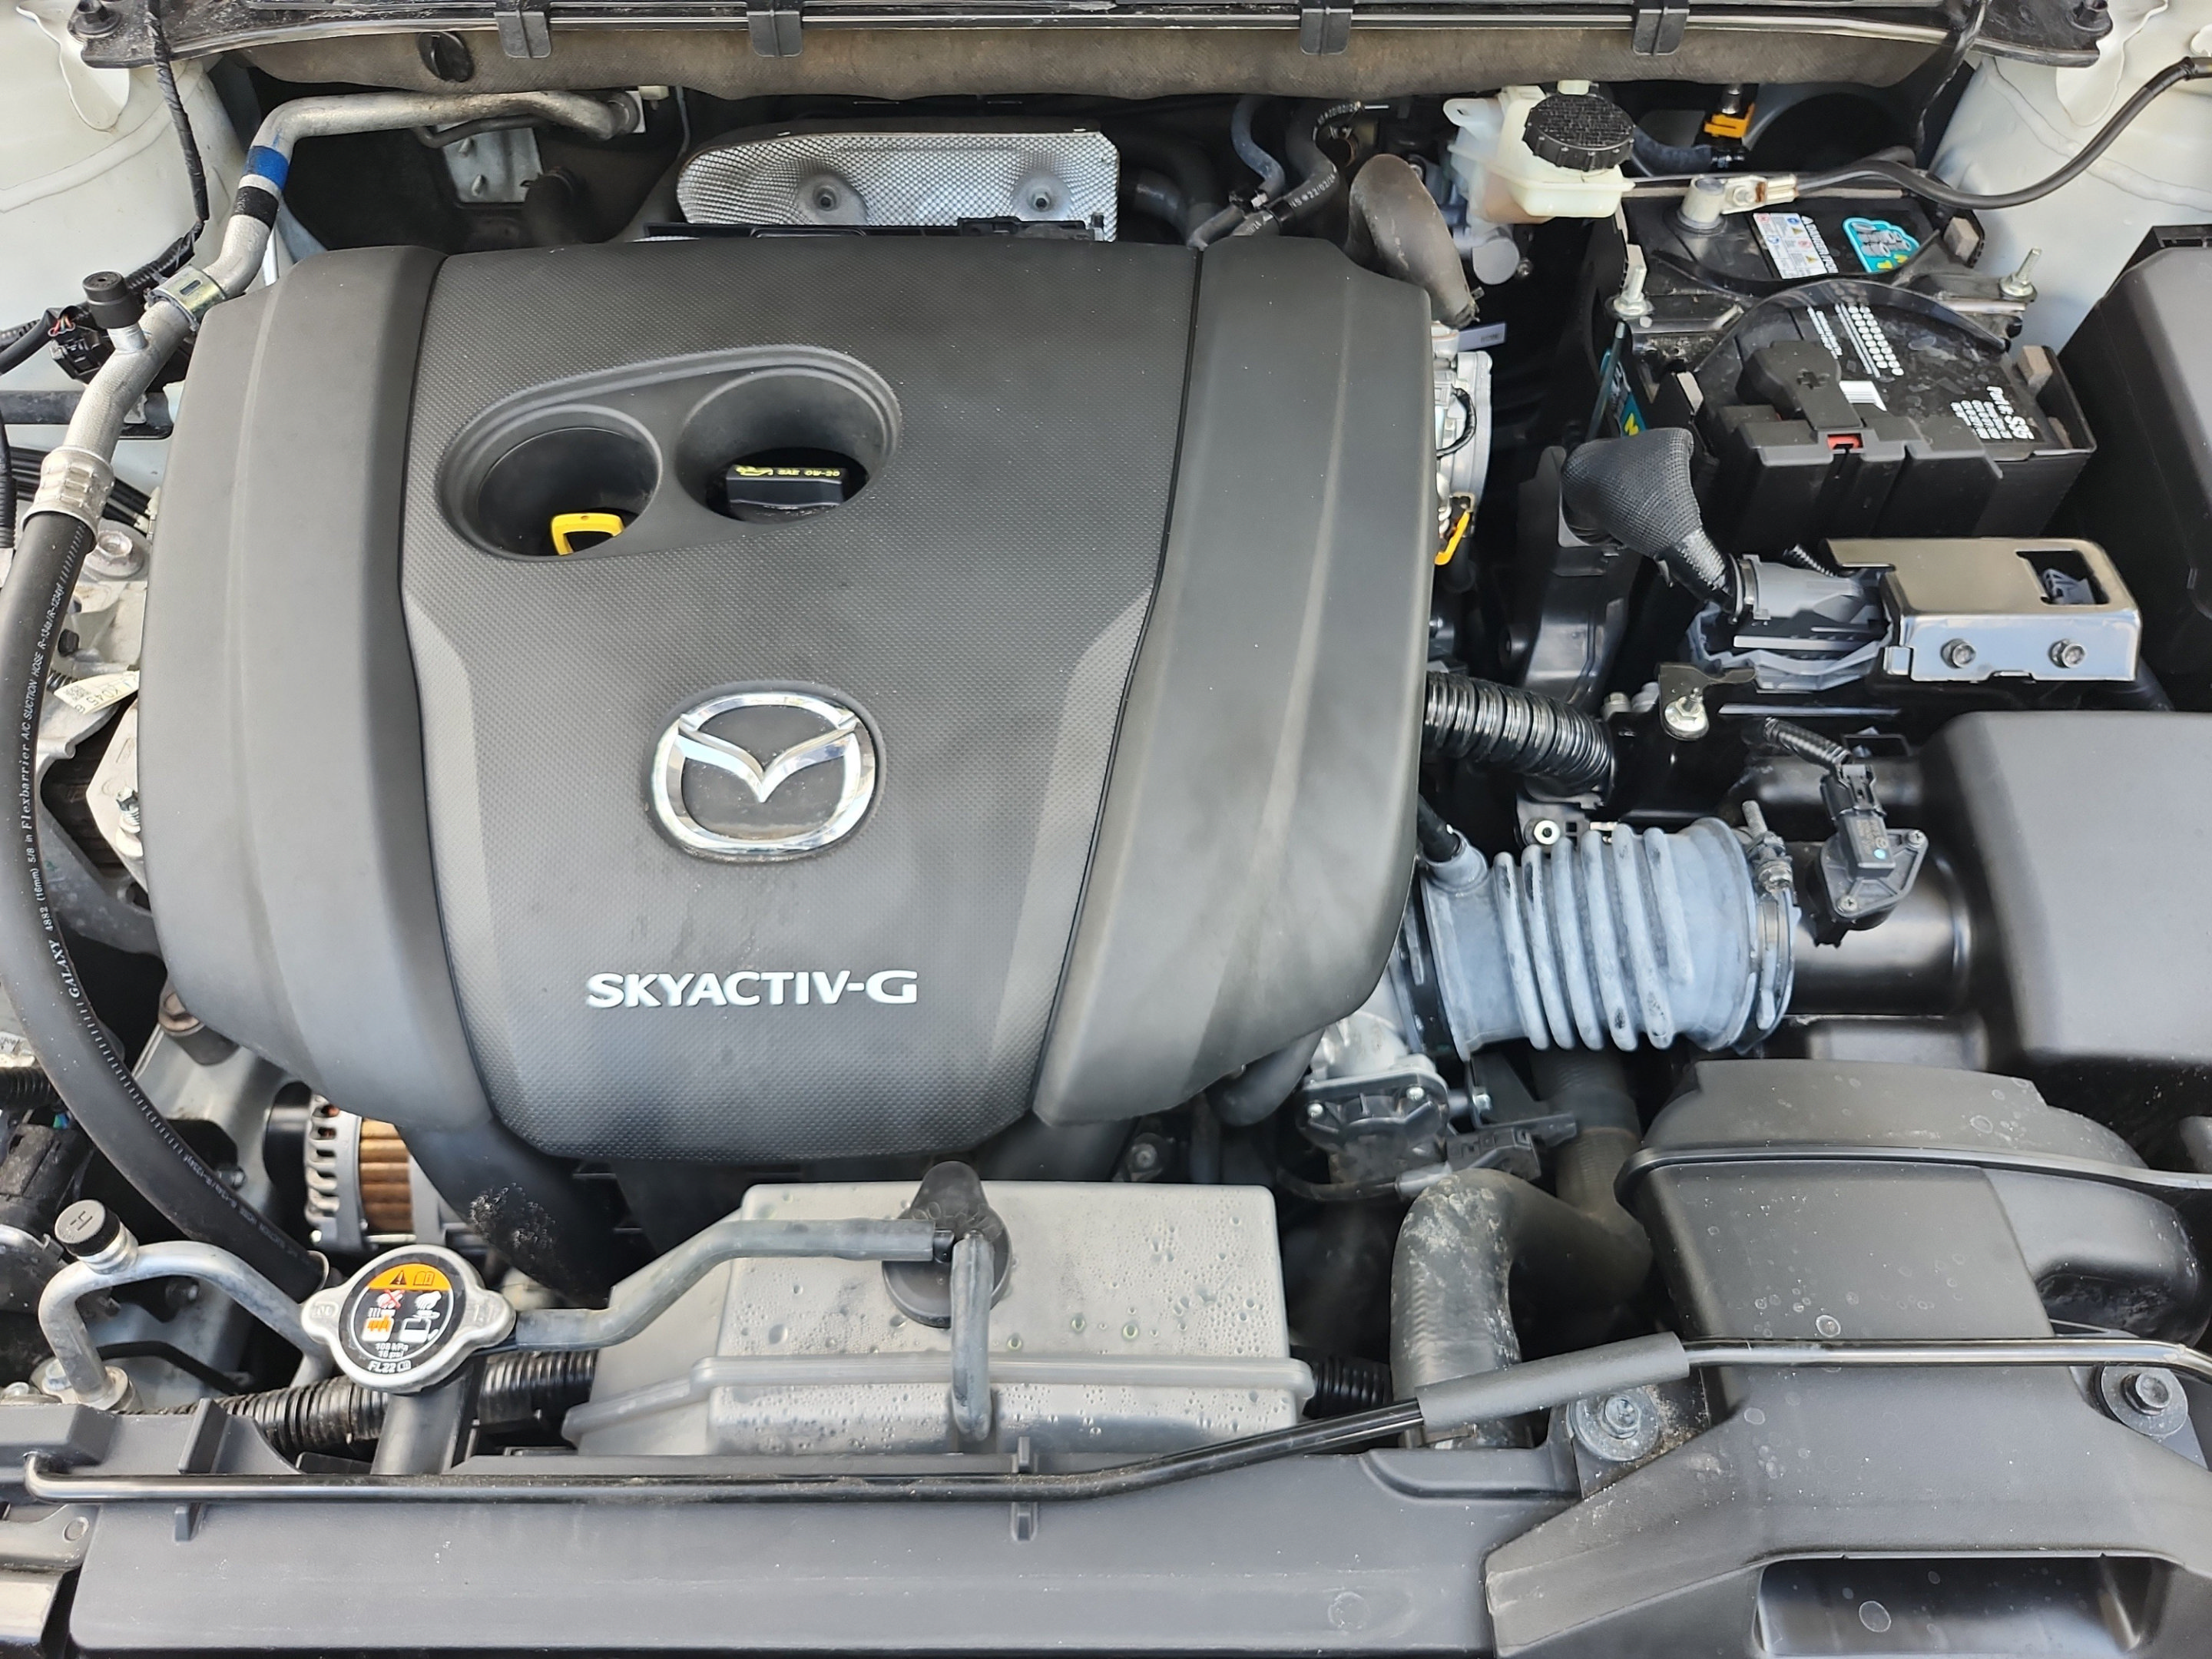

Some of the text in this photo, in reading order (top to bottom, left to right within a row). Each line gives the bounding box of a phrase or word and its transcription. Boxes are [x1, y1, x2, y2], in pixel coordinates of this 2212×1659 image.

[2004, 415, 2035, 440] S35
[31, 651, 44, 677] HOSE
[23, 679, 38, 720] SUCTION
[21, 721, 31, 740] A/C
[19, 743, 33, 830] Flexbarrier
[25, 834, 34, 843] in
[26, 847, 37, 863] 5/8
[30, 868, 46, 902] (16mm)
[39, 906, 54, 932] 4882
[48, 939, 81, 998] GALAXY
[585, 969, 918, 1008] SKYACTIV-G
[389, 1350, 405, 1359] psi
[391, 1342, 409, 1352] kPa
[369, 1359, 396, 1373] FL22
